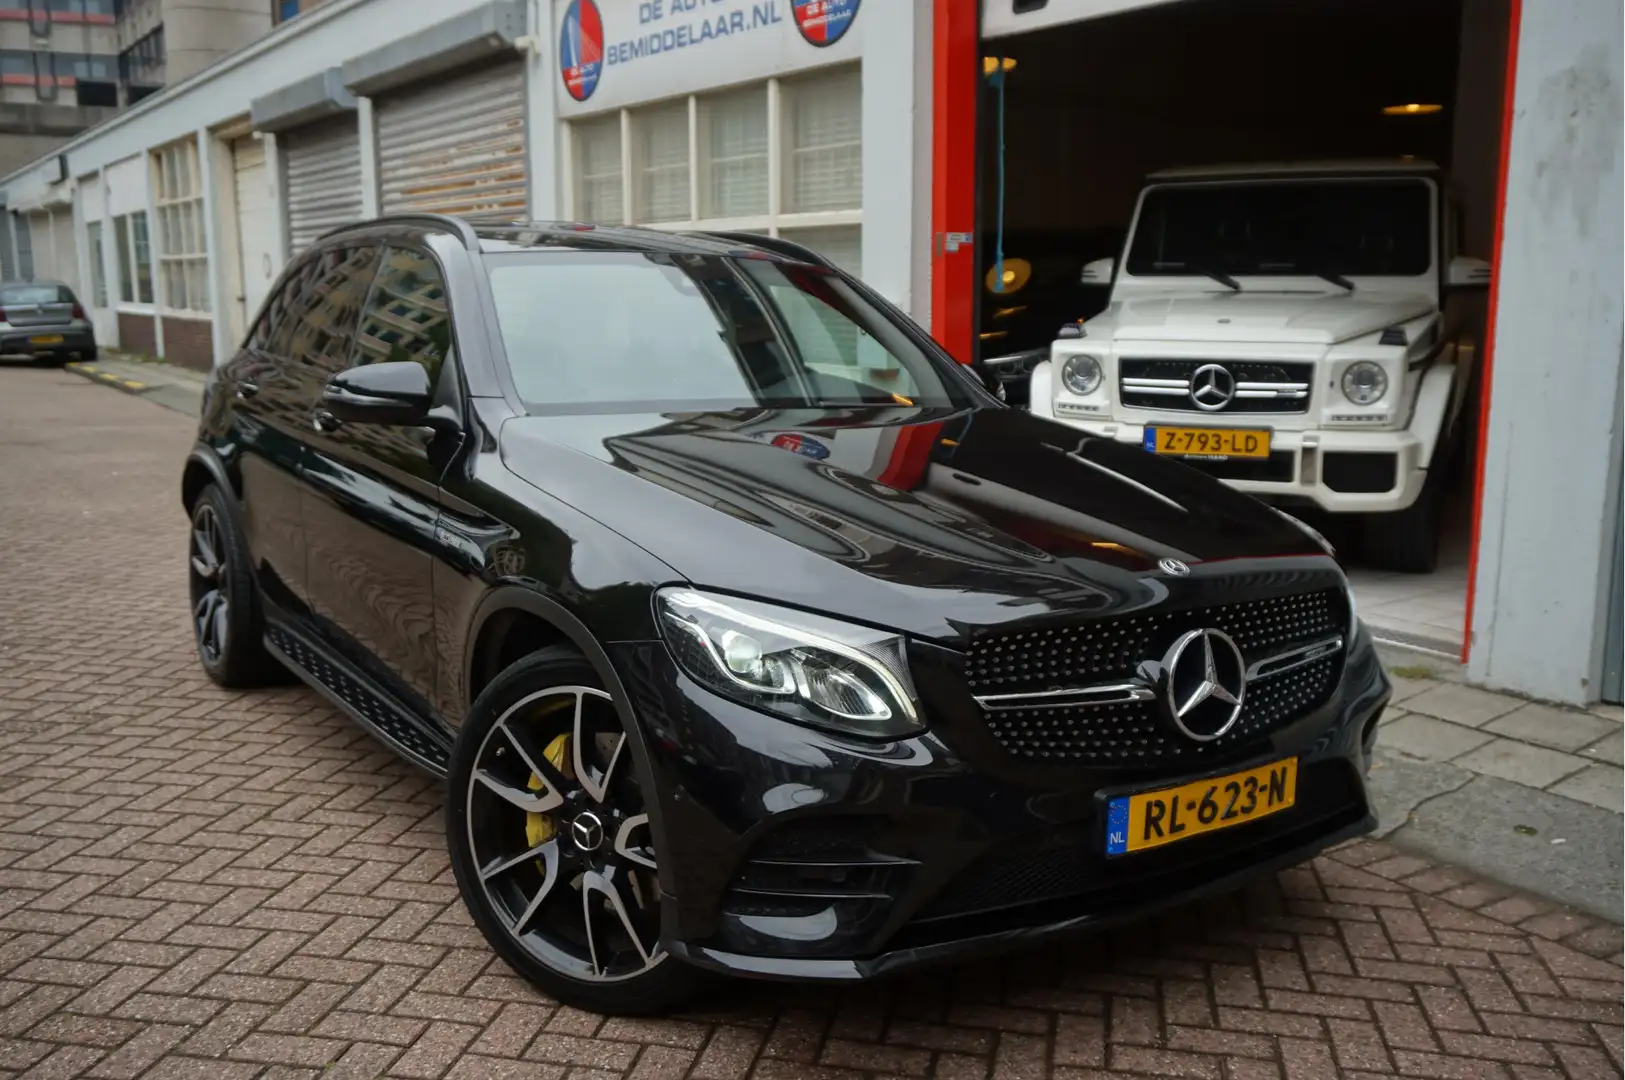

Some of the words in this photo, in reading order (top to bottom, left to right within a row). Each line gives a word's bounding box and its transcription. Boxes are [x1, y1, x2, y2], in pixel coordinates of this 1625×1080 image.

[639, 2, 663, 24] DE
[670, 0, 721, 15] AU
[606, 4, 783, 65] BEMIDDELAAR.NL
[1165, 432, 1258, 453] Z-793-LD
[1110, 831, 1125, 845] NL
[1143, 766, 1288, 841] RL-623-N
